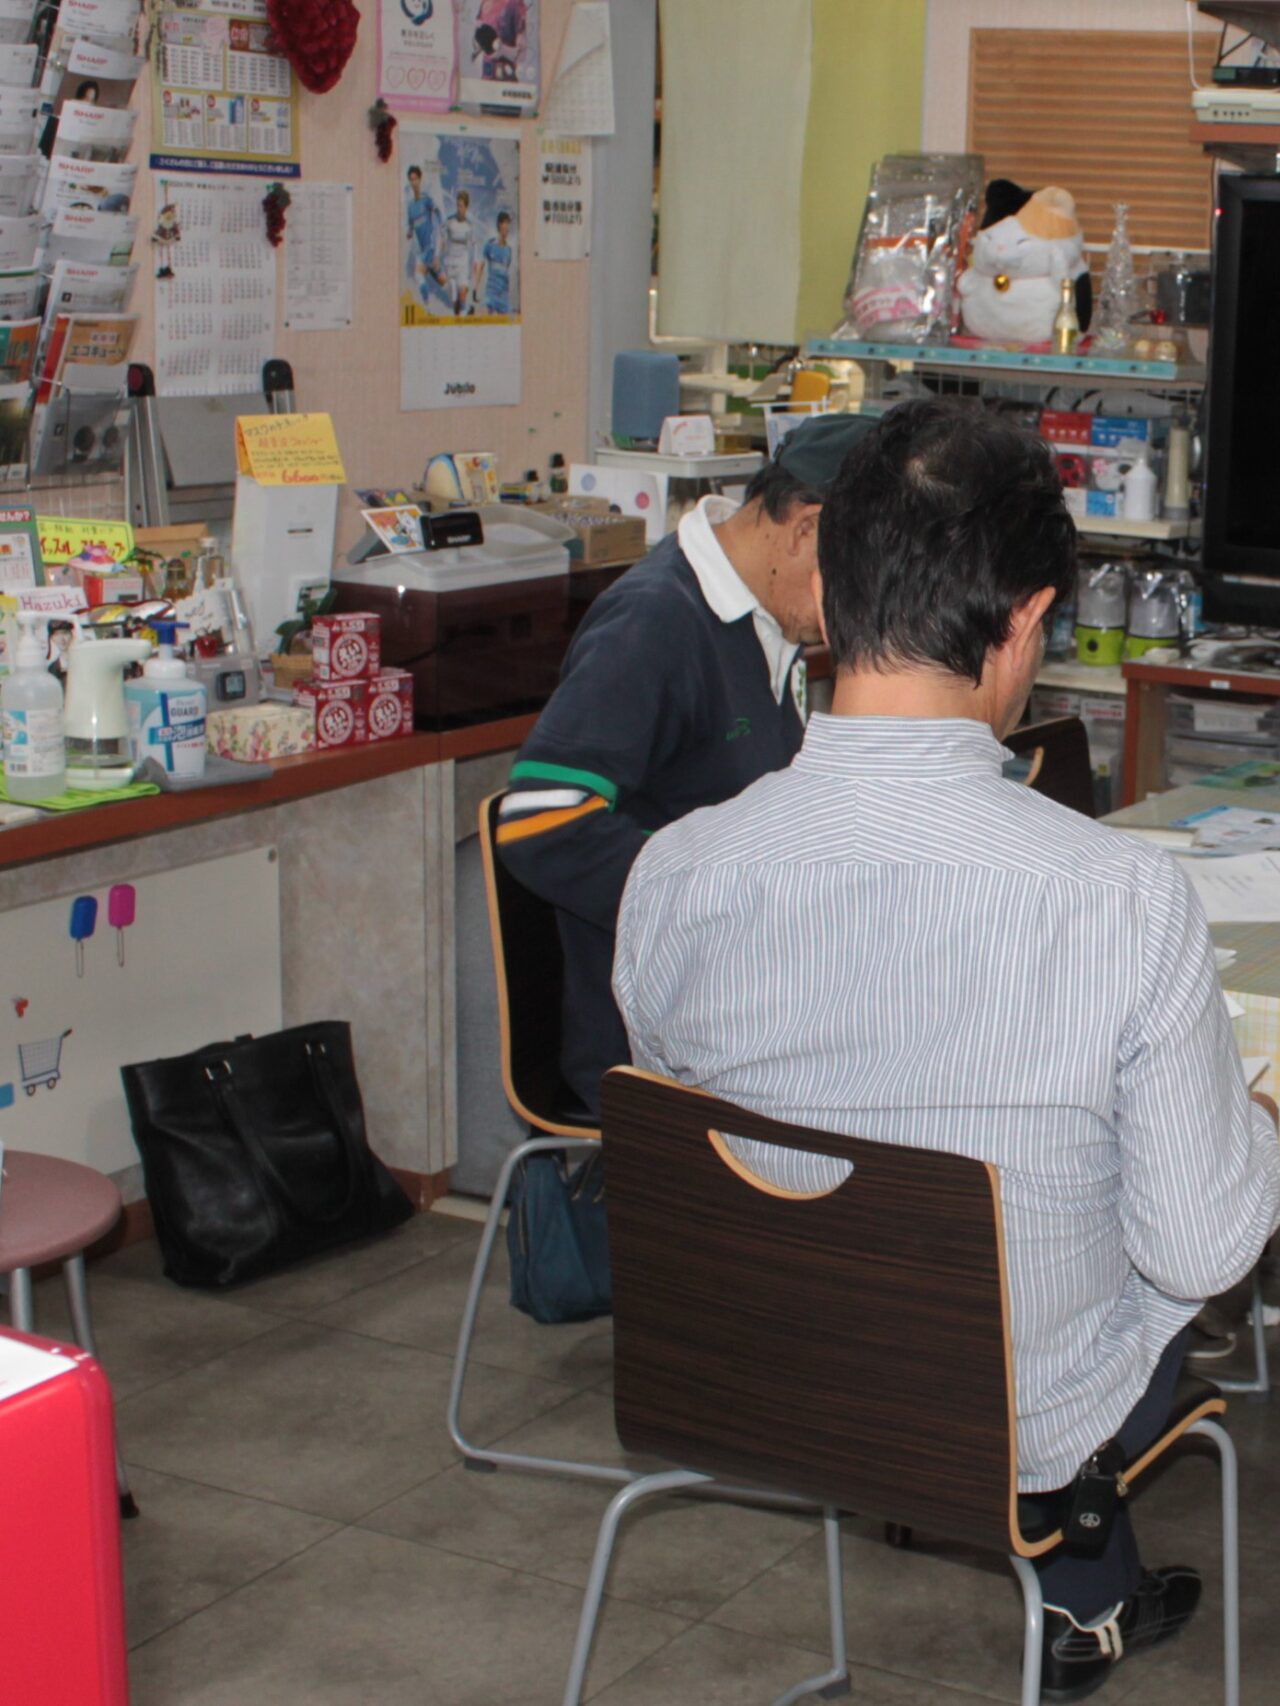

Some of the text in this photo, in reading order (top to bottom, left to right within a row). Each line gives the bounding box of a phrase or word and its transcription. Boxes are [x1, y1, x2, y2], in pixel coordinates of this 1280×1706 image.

[68, 0, 98, 10] SHARP
[76, 54, 108, 65] SHARP
[73, 109, 105, 119] SHARP
[58, 162, 95, 173] SHARP
[64, 214, 95, 224] SHARP
[66, 268, 98, 276] SHARP
[21, 594, 83, 612] Hazuki
